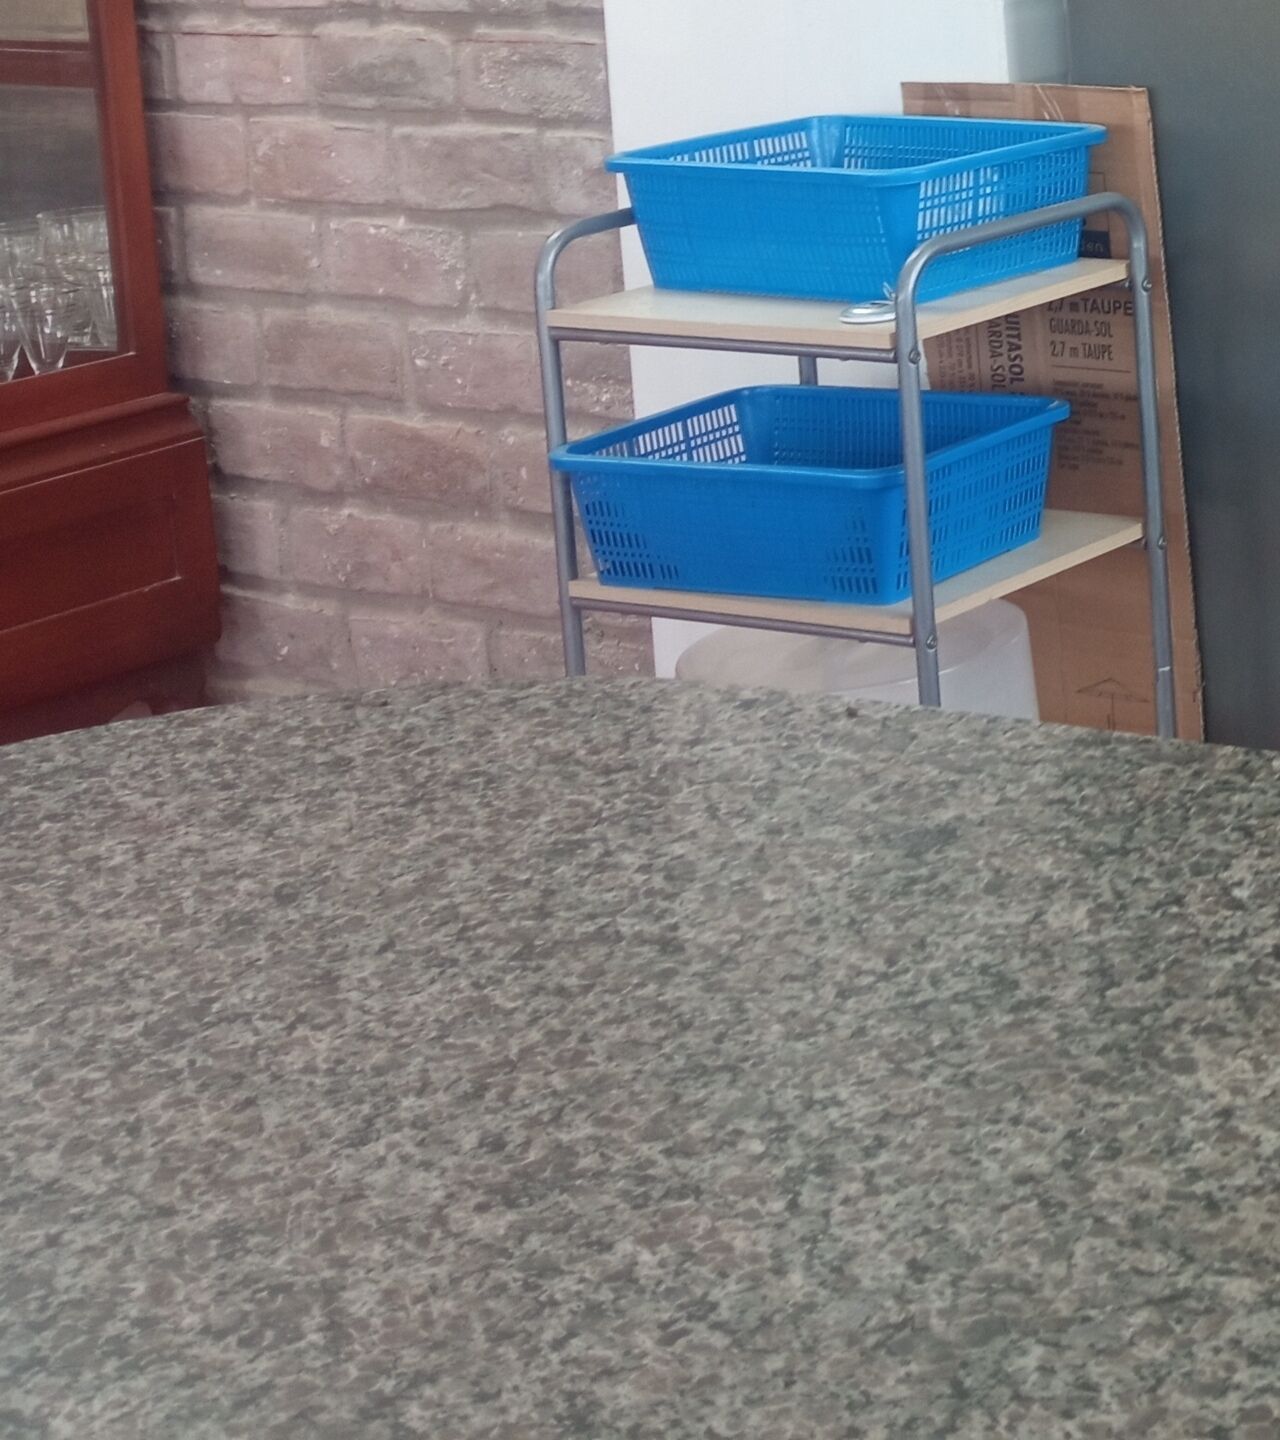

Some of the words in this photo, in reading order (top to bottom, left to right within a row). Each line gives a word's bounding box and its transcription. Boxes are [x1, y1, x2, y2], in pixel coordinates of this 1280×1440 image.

[1080, 298, 1134, 317] TAUPE
[1049, 317, 1114, 338] GUARDA-SOL
[987, 319, 1006, 392] ARDA-SOL
[1005, 312, 1025, 385] UITASOL
[1081, 343, 1114, 361] TAUPE
